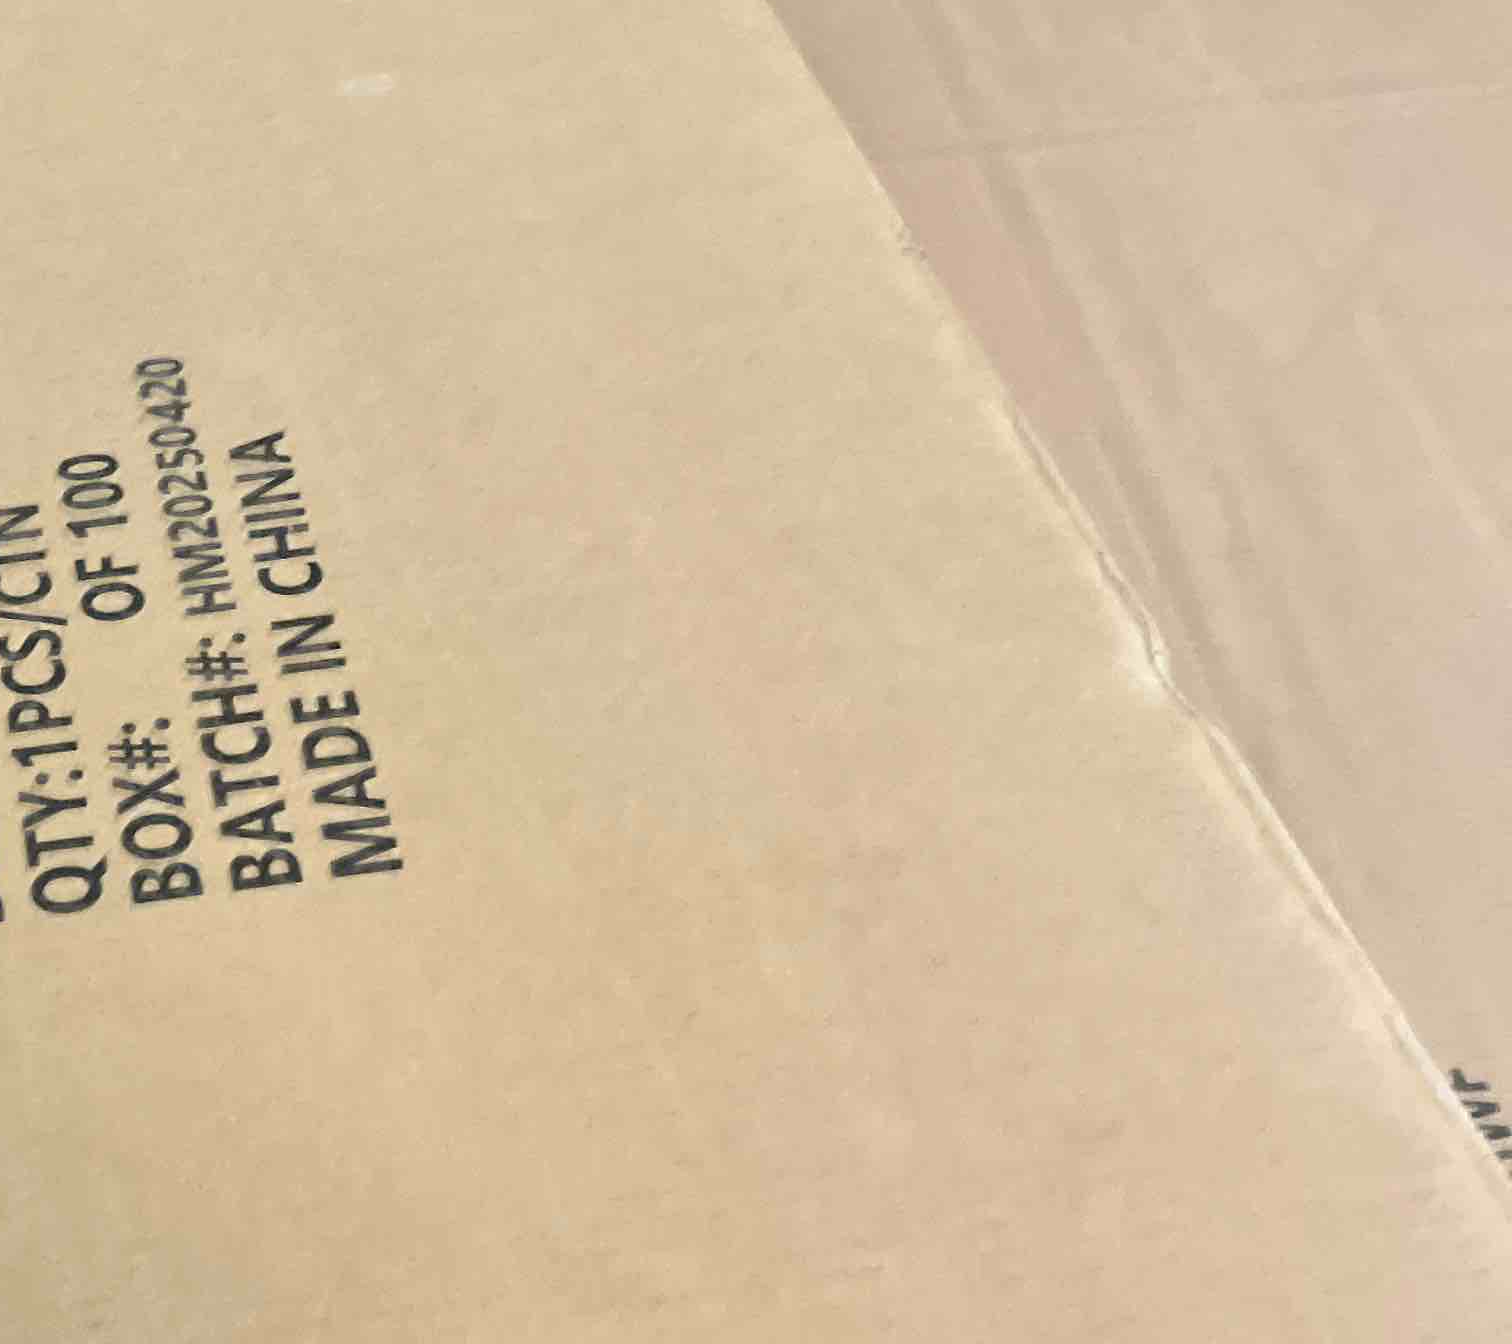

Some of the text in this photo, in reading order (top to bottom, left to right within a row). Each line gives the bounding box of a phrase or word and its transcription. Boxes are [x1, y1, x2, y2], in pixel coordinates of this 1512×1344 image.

[57, 453, 203, 905] BOX#: OF 100
[135, 355, 303, 891] BATCH#: HM20250420
[229, 428, 404, 878] MADE IN CHINA
